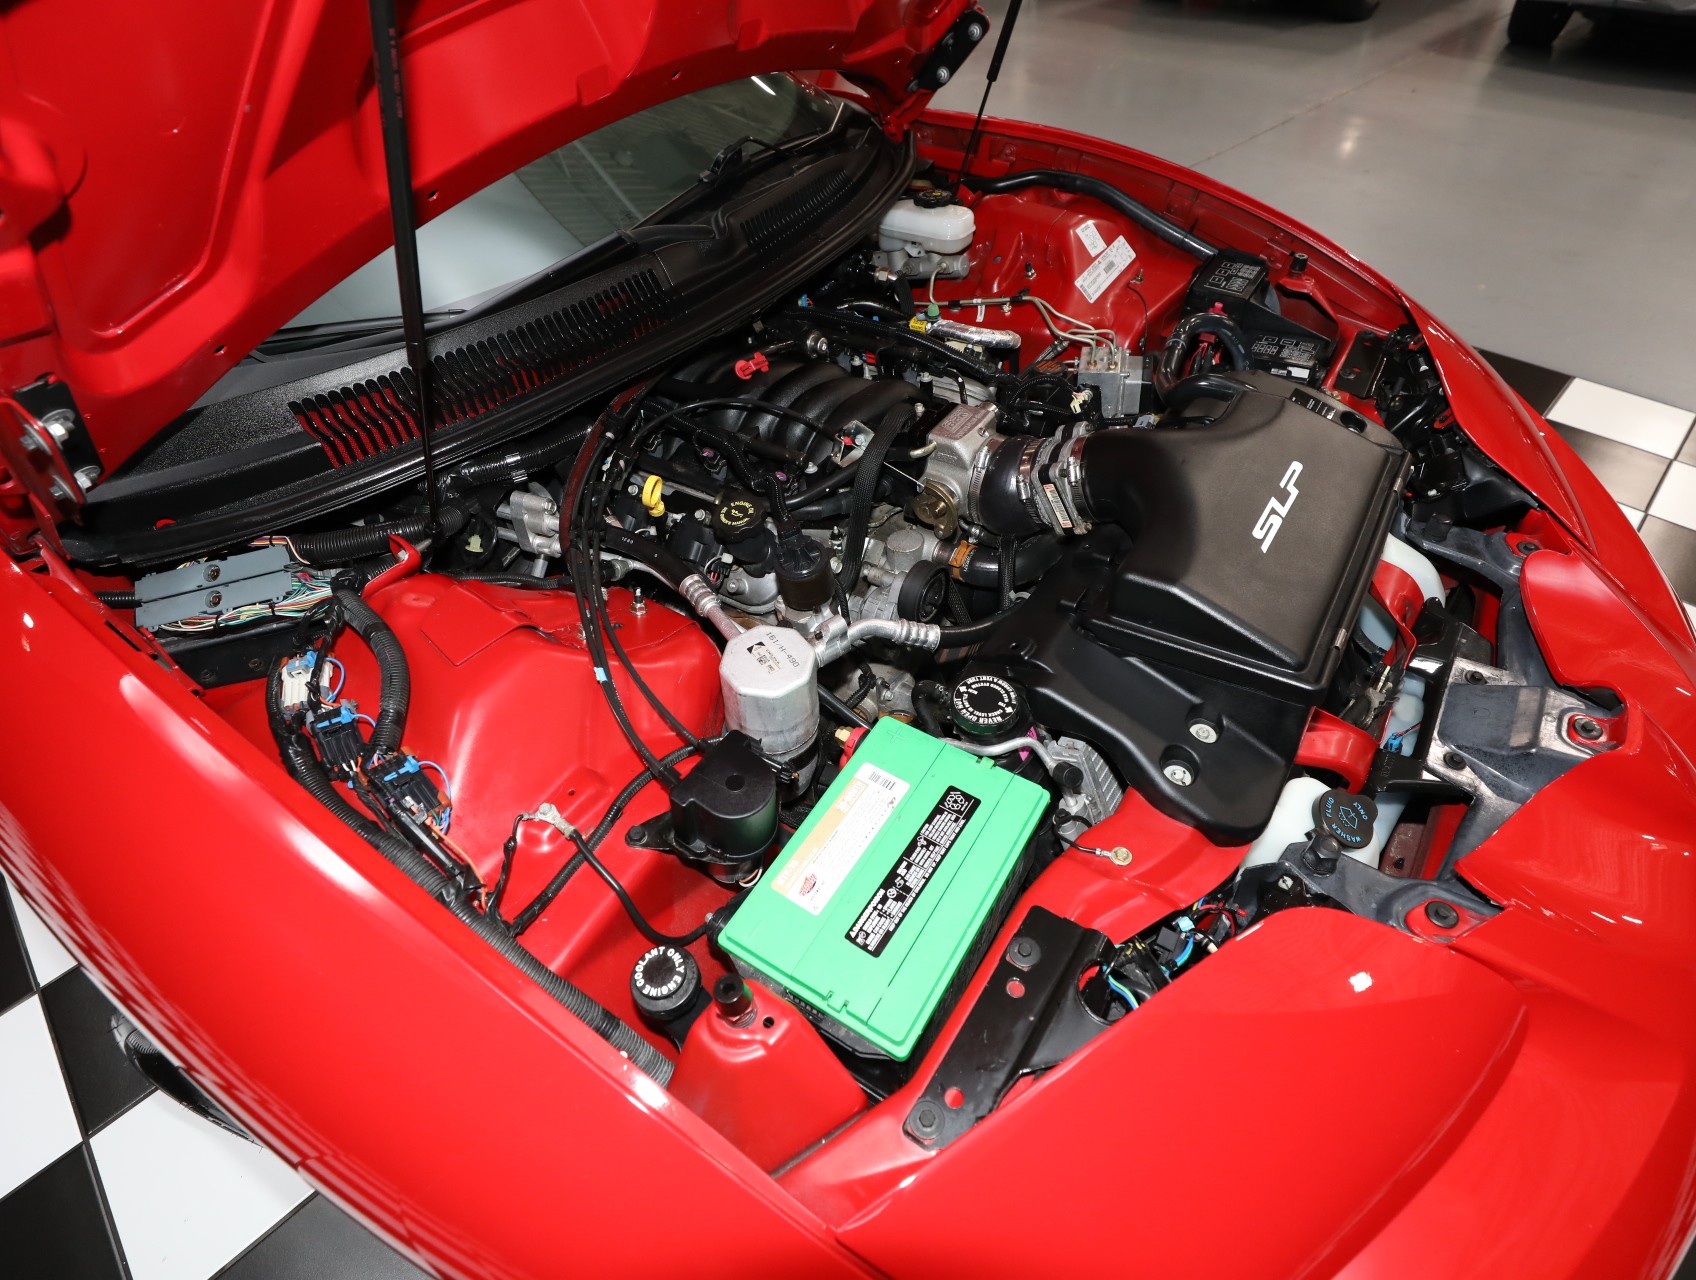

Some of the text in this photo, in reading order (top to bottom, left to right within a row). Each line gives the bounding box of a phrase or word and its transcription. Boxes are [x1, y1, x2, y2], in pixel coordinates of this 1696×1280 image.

[1252, 461, 1303, 553] SLP
[954, 698, 1002, 724] NEVER OPEN HOT
[1325, 797, 1368, 842] WASHER FLUID ONLY
[634, 946, 685, 996] ENGINE COOLANT ONLY
